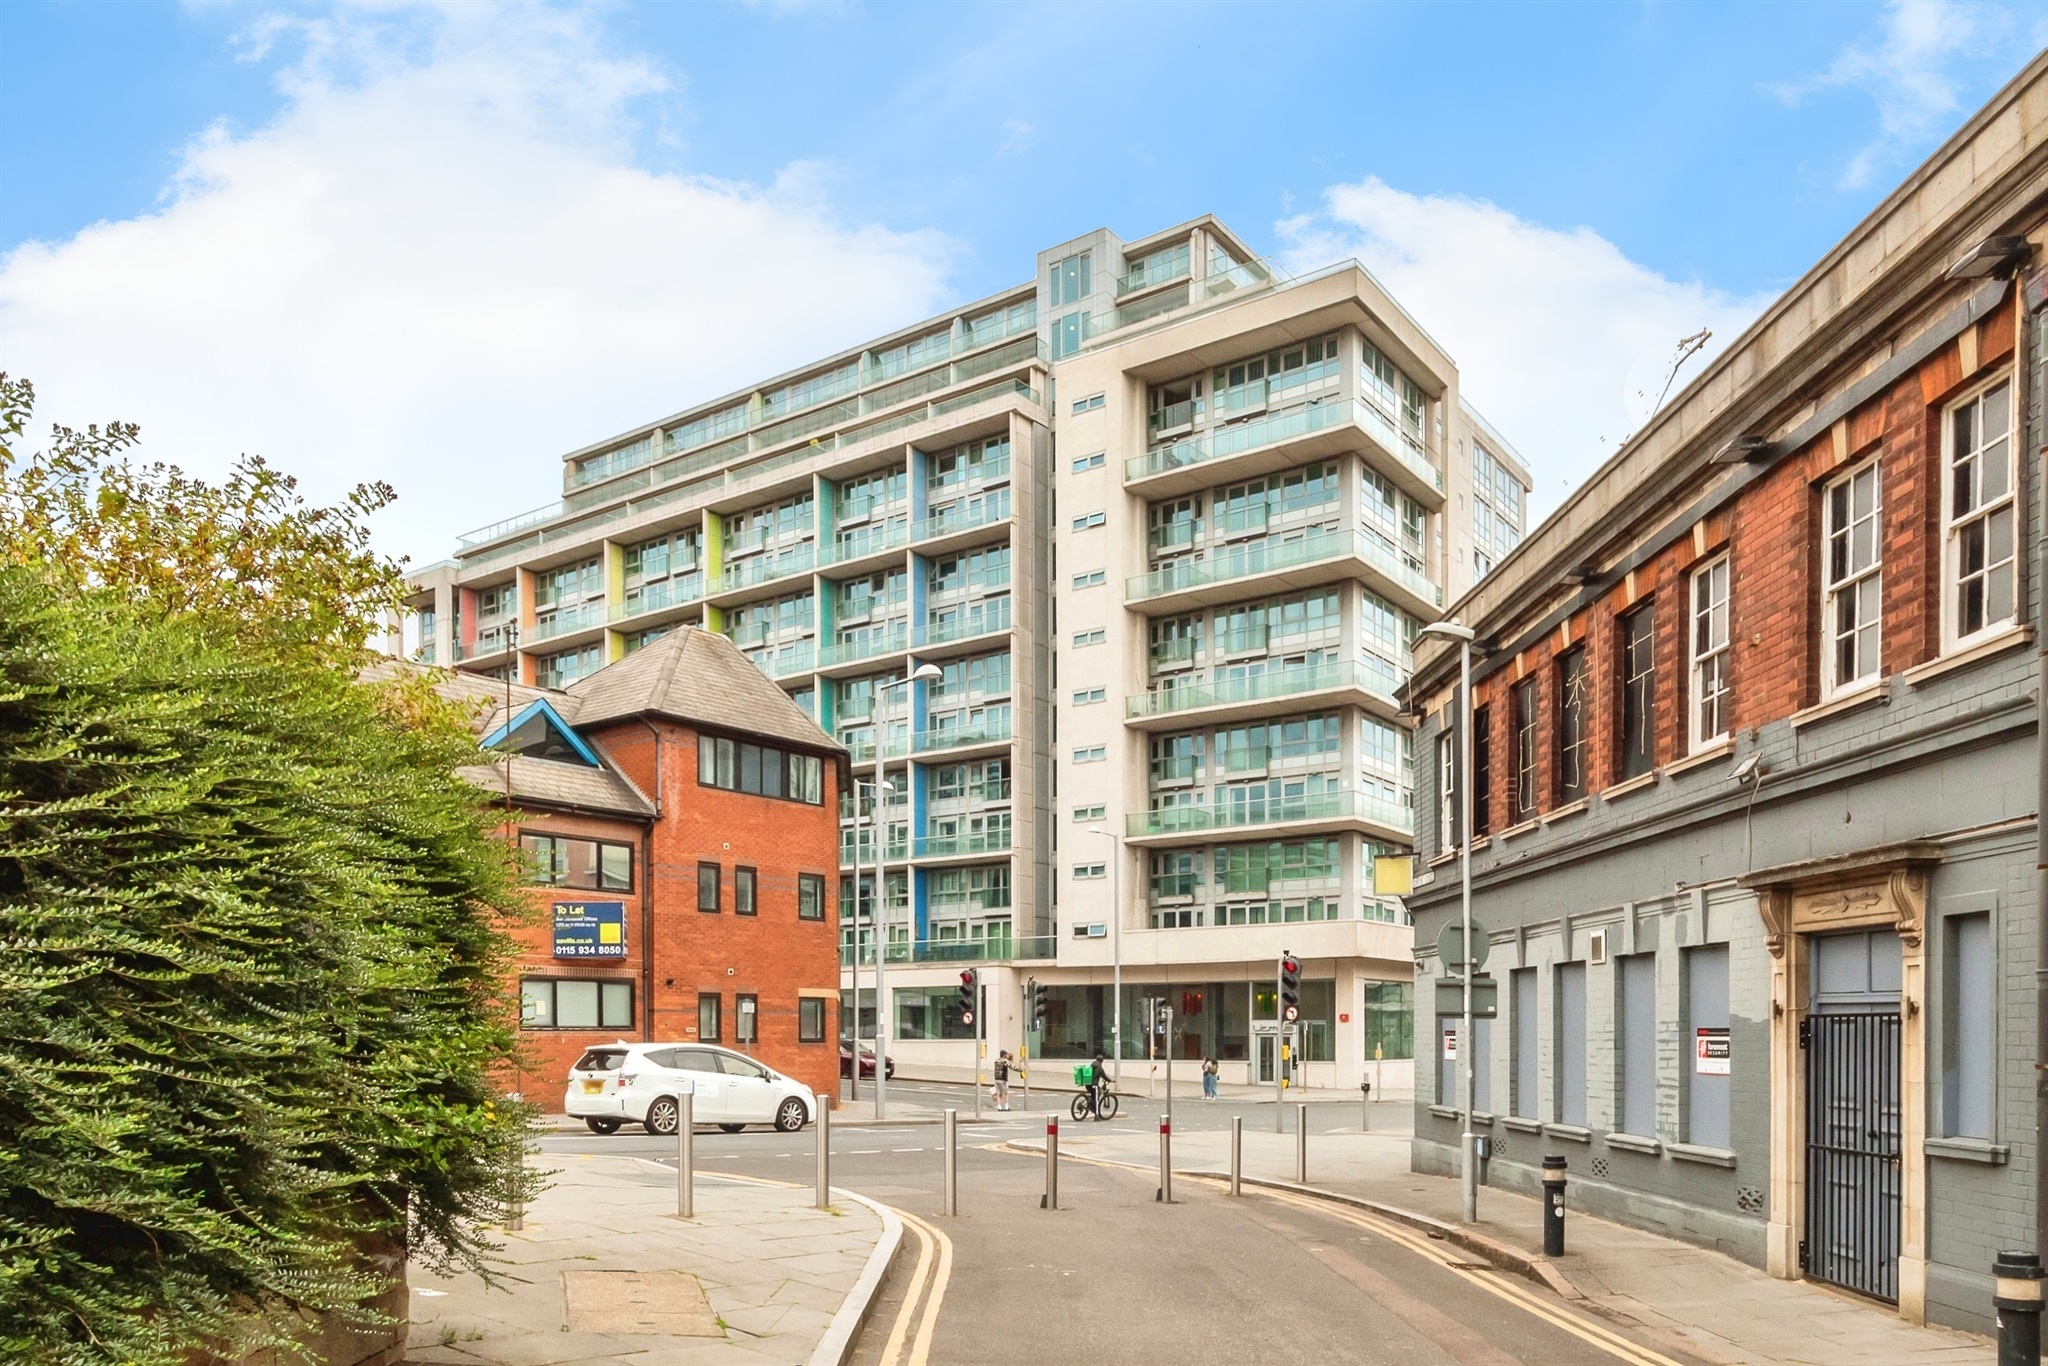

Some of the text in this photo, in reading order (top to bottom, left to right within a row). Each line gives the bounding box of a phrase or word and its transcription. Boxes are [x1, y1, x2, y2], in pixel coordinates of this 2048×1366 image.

[556, 905, 585, 914] To Let
[556, 946, 621, 954] 0115 934 8050
